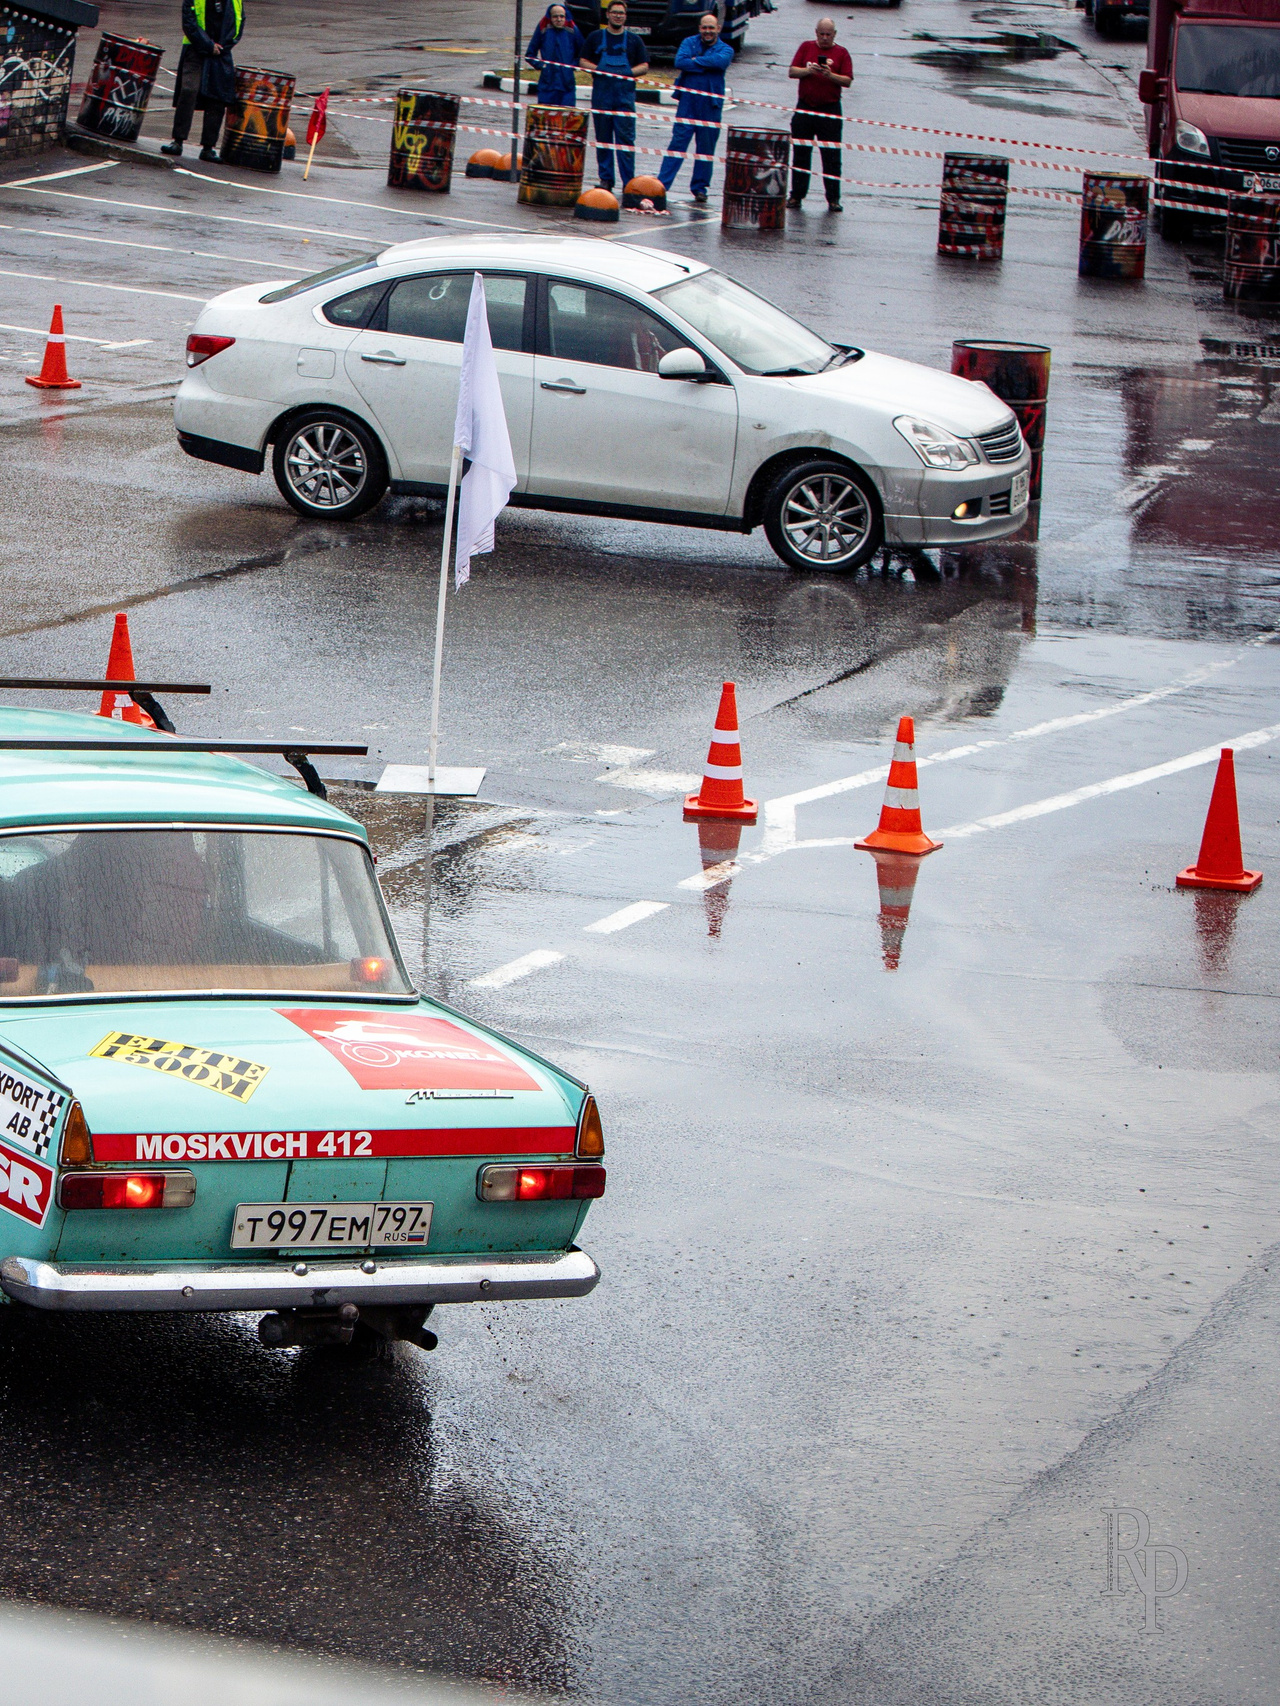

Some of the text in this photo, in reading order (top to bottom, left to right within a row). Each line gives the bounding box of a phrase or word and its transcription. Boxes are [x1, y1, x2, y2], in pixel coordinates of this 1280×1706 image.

[113, 1033, 265, 1081] ELITE
[395, 1049, 506, 1063] KONELA
[6, 1112, 32, 1138] AB
[135, 1131, 373, 1160] MOSKVICH 412
[377, 1206, 424, 1232] 797
[383, 1232, 407, 1242] RUS
